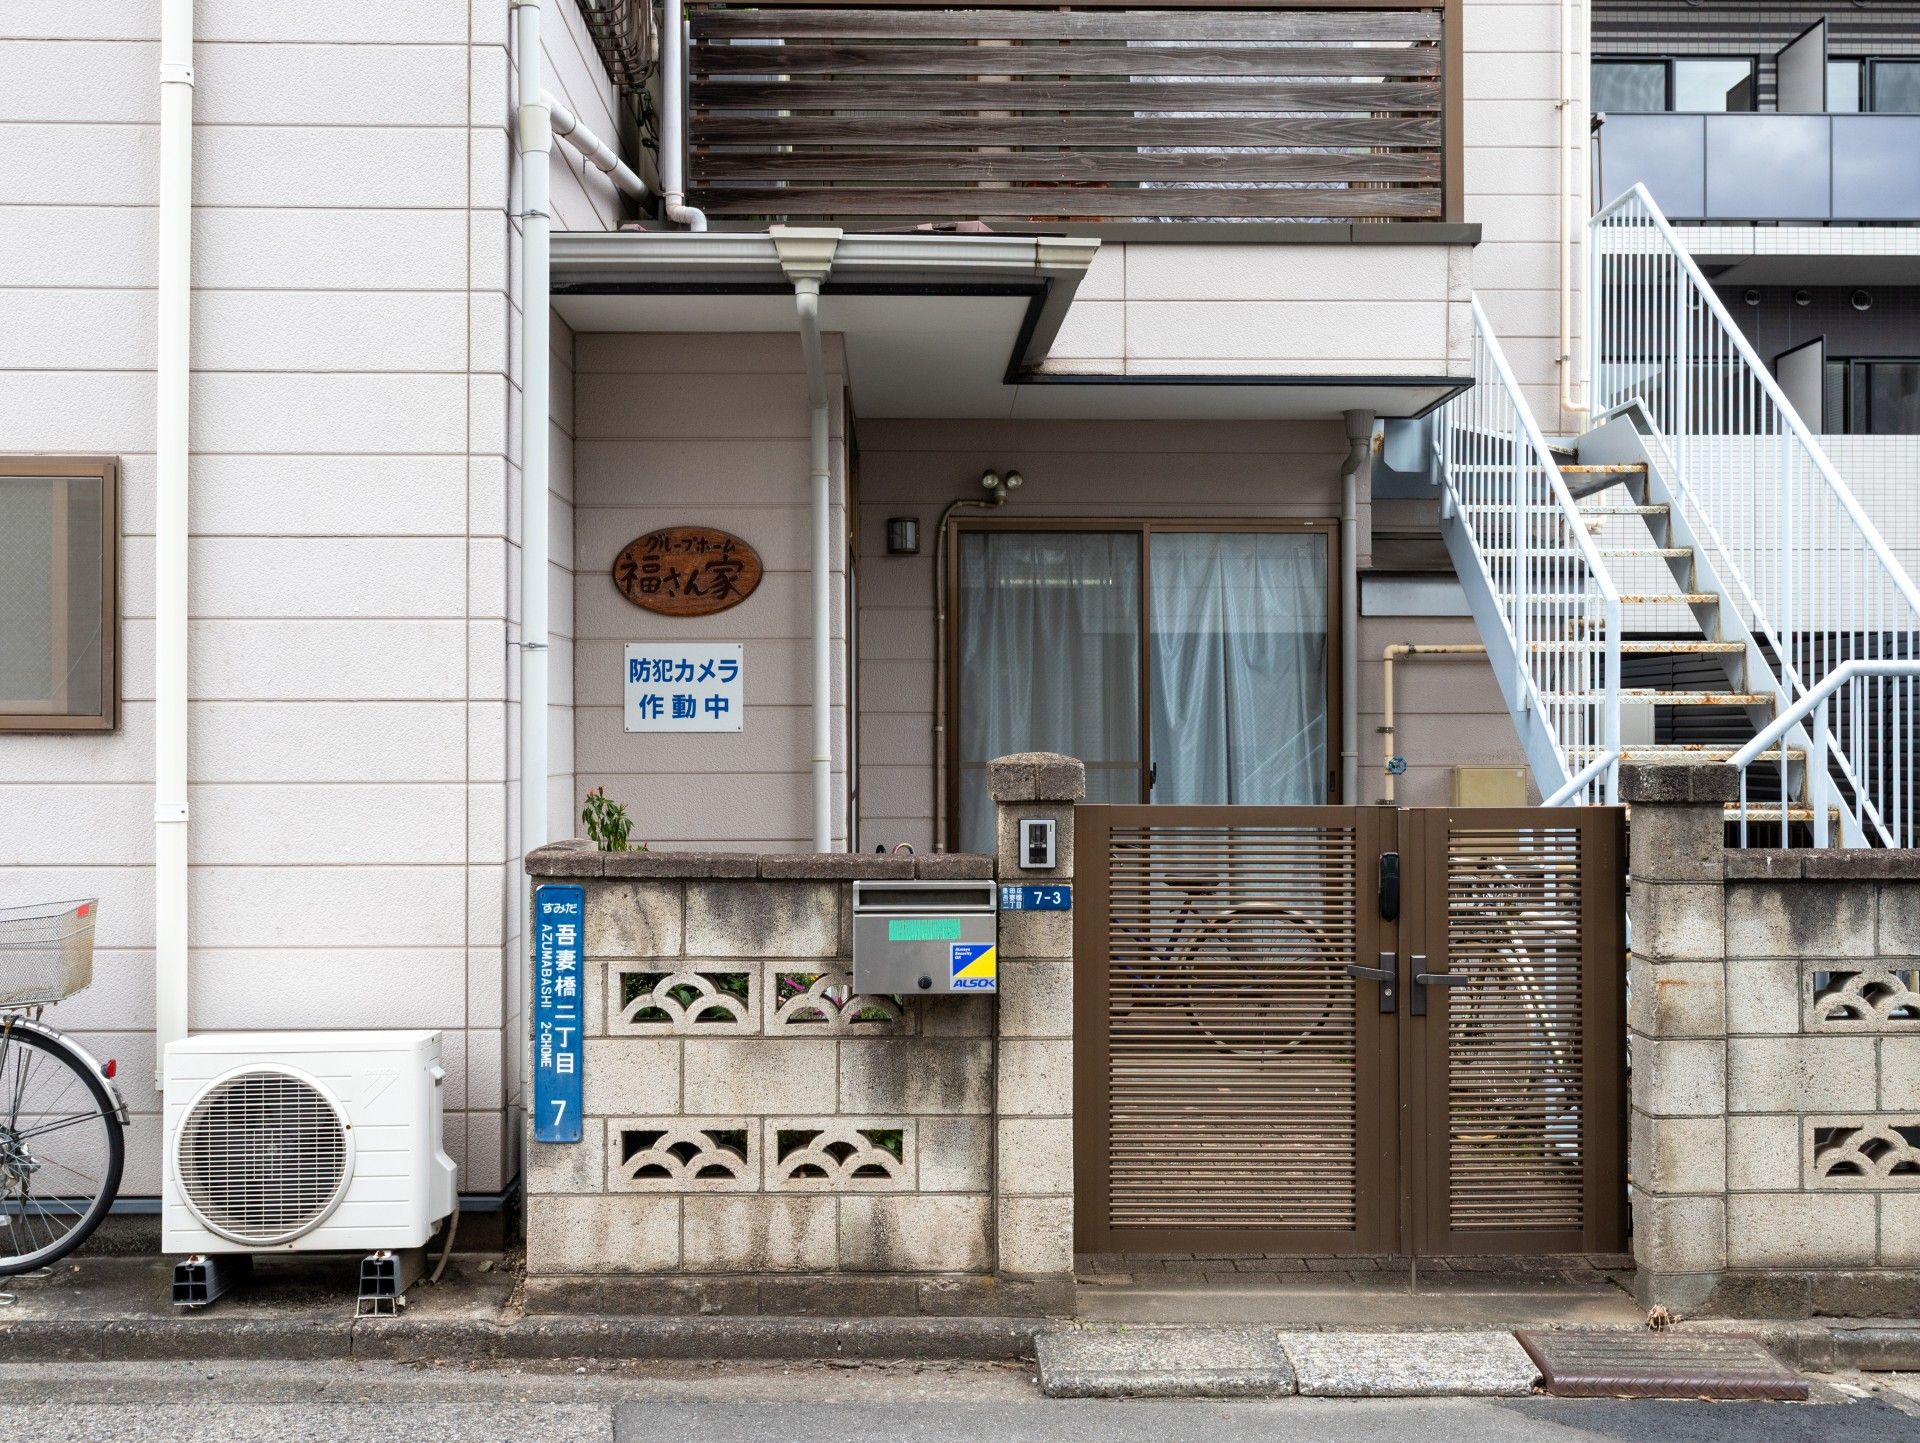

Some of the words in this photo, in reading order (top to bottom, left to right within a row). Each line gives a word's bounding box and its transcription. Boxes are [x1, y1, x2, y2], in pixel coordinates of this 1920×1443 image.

[619, 553, 744, 600] 福さん家
[629, 658, 739, 683] 防犯カメラ
[638, 694, 729, 720] 作動中
[541, 902, 578, 915] すみだ
[1034, 891, 1061, 904] 7-3
[540, 923, 553, 1009] AZUMABASHI
[953, 979, 995, 988] ALSOK
[554, 923, 578, 1075] 吾妻橋二丁目
[540, 1021, 552, 1068] 2-CHOME
[549, 1099, 567, 1126] 7
